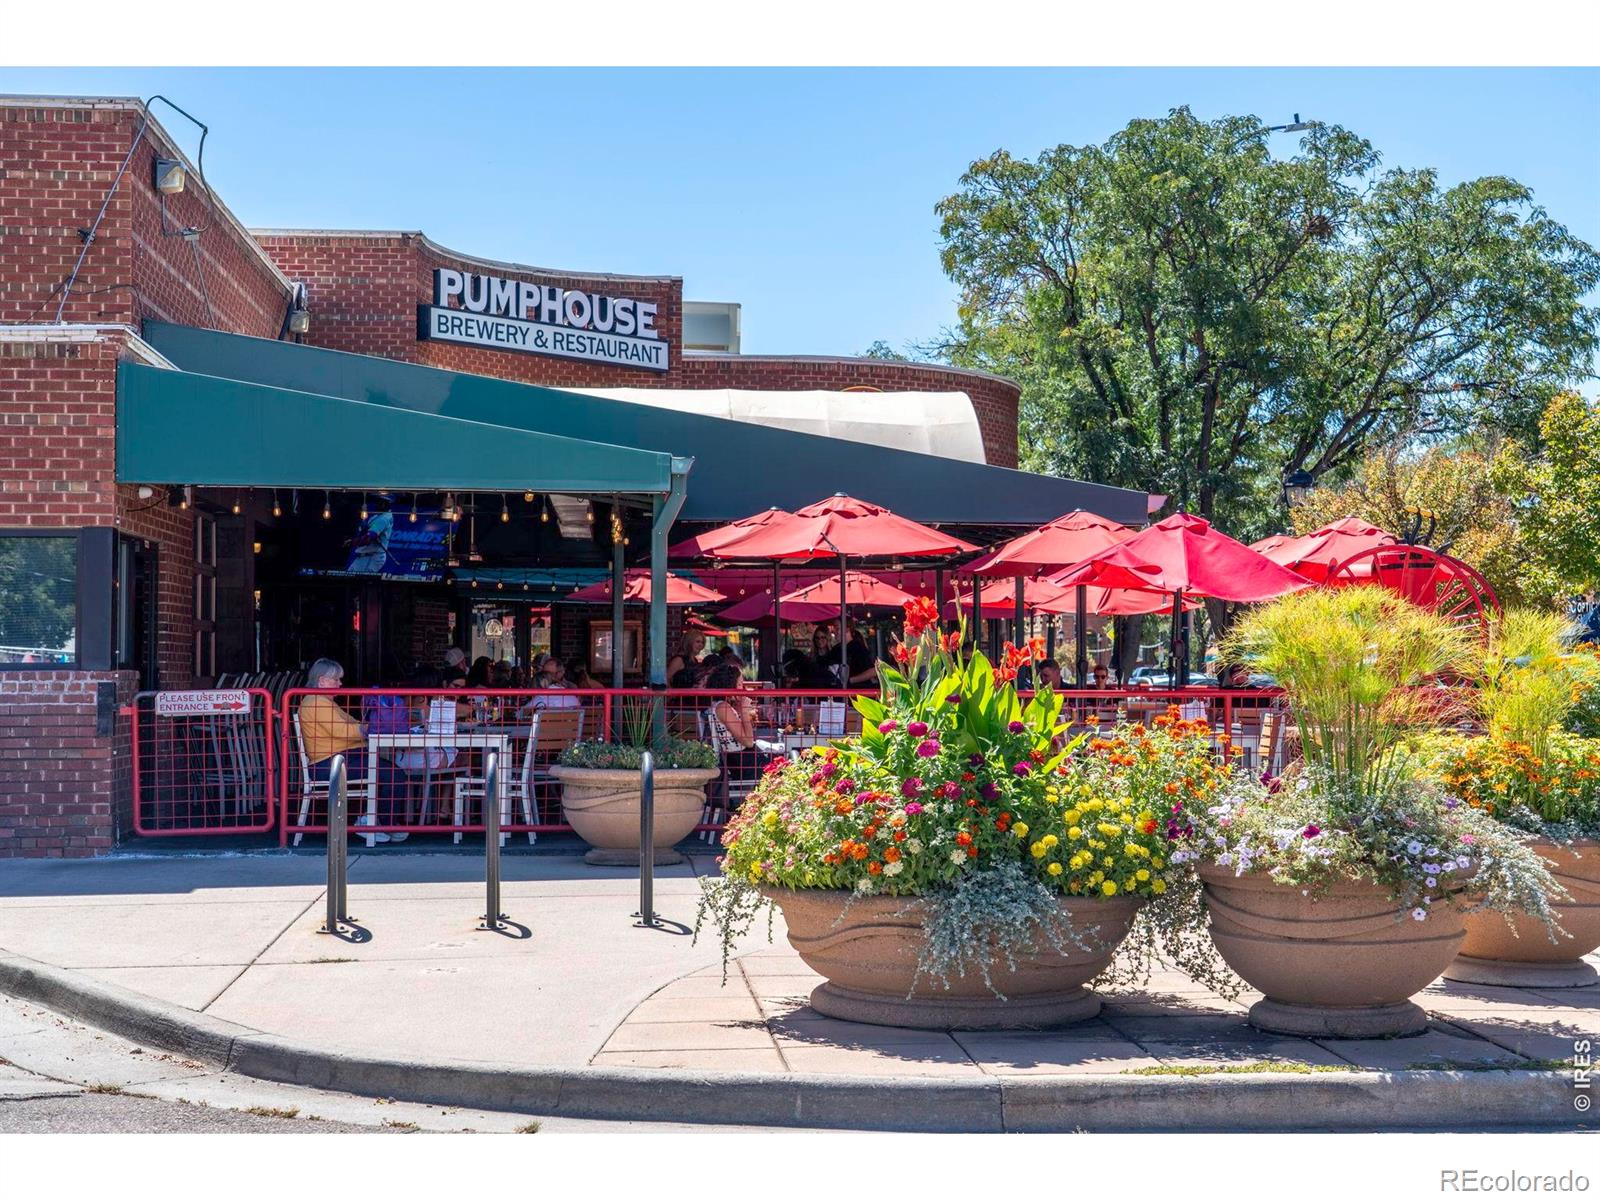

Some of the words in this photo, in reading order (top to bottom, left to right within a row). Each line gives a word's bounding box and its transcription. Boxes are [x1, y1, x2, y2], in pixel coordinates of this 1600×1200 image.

[438, 268, 658, 339] PUMPHOUSE
[437, 314, 530, 345] BREWERY
[534, 329, 549, 349] &
[553, 333, 662, 364] RESTAURANT
[160, 694, 195, 702] PLEASE
[196, 694, 215, 702] USE
[216, 693, 246, 701] FRONT
[160, 703, 208, 711] ENTRANCE
